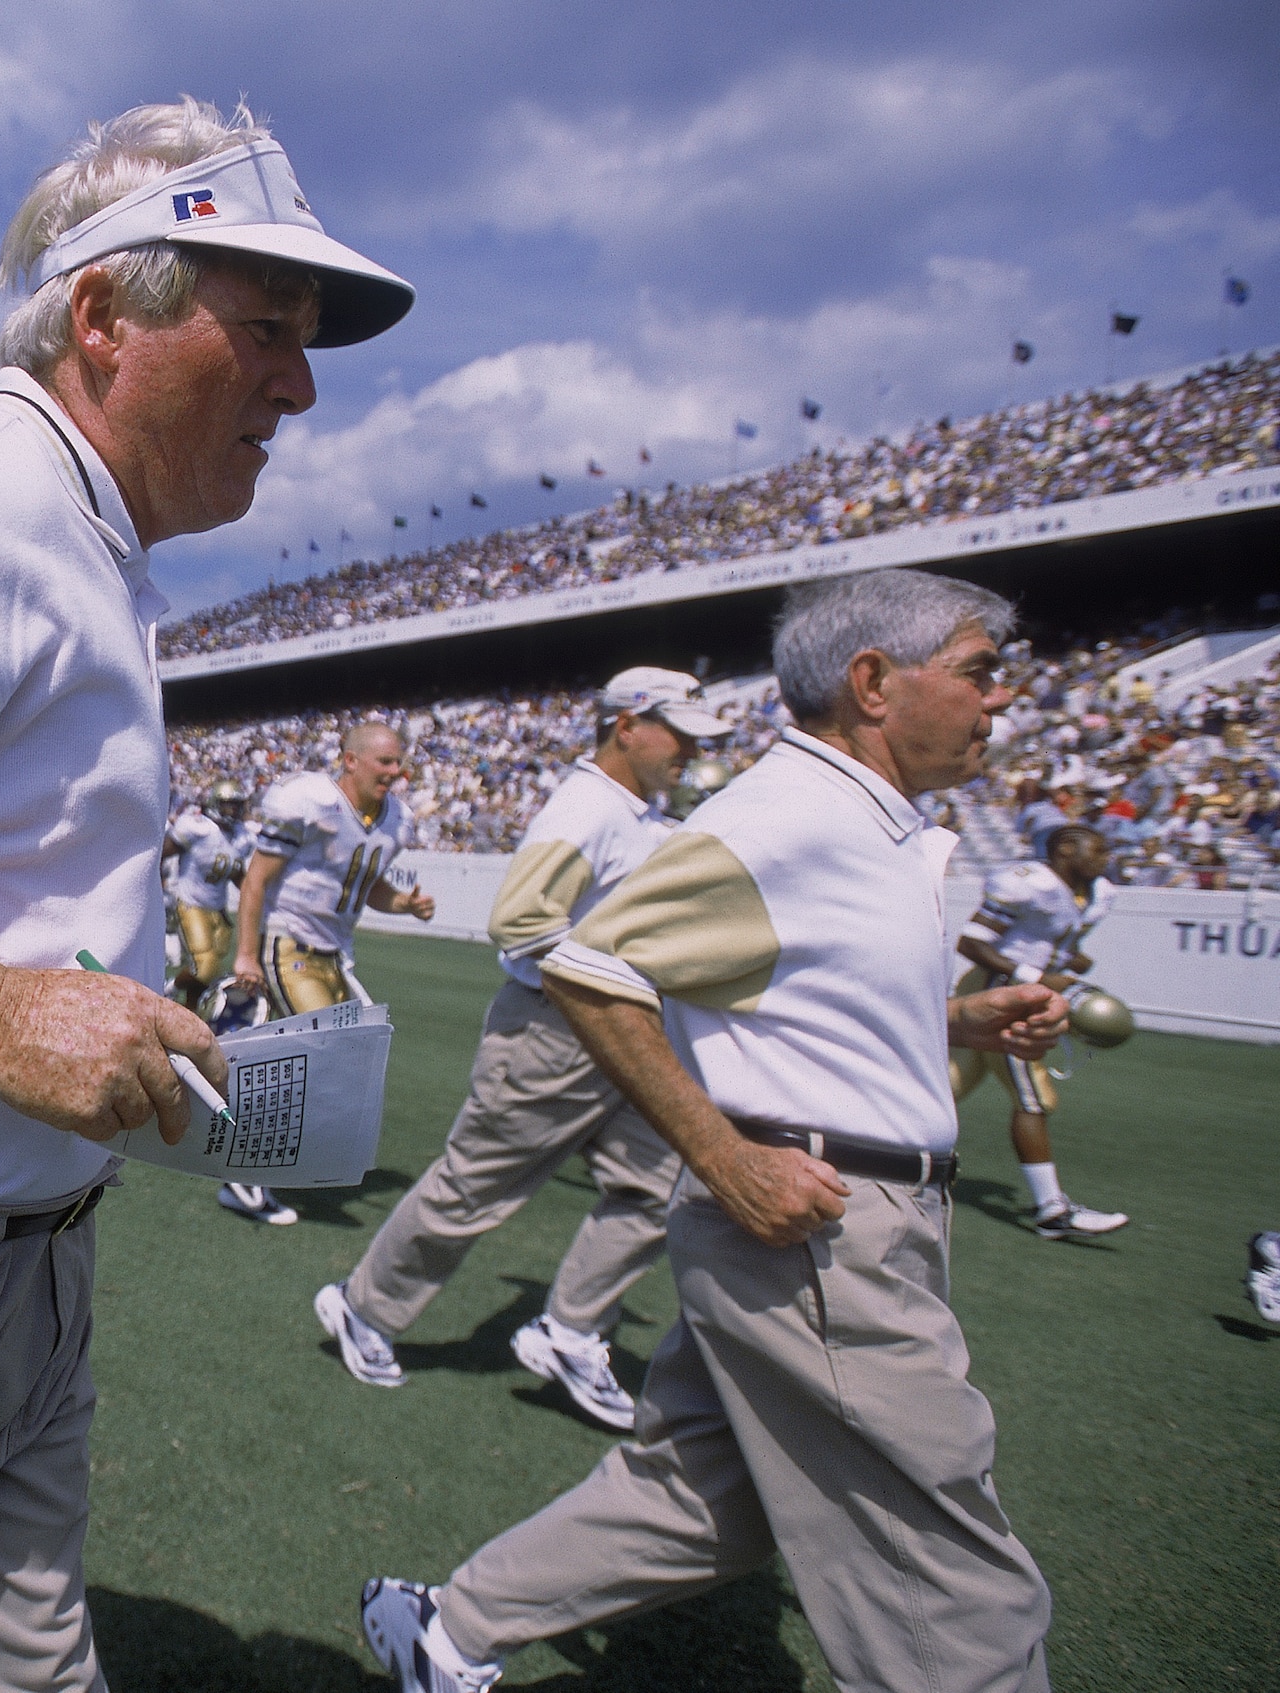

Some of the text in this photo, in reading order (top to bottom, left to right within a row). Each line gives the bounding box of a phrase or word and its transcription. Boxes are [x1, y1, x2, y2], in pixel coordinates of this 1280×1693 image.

[335, 841, 383, 913] 11
[256, 1094, 264, 1109] 0:50
[267, 1115, 275, 1128] 0:45
